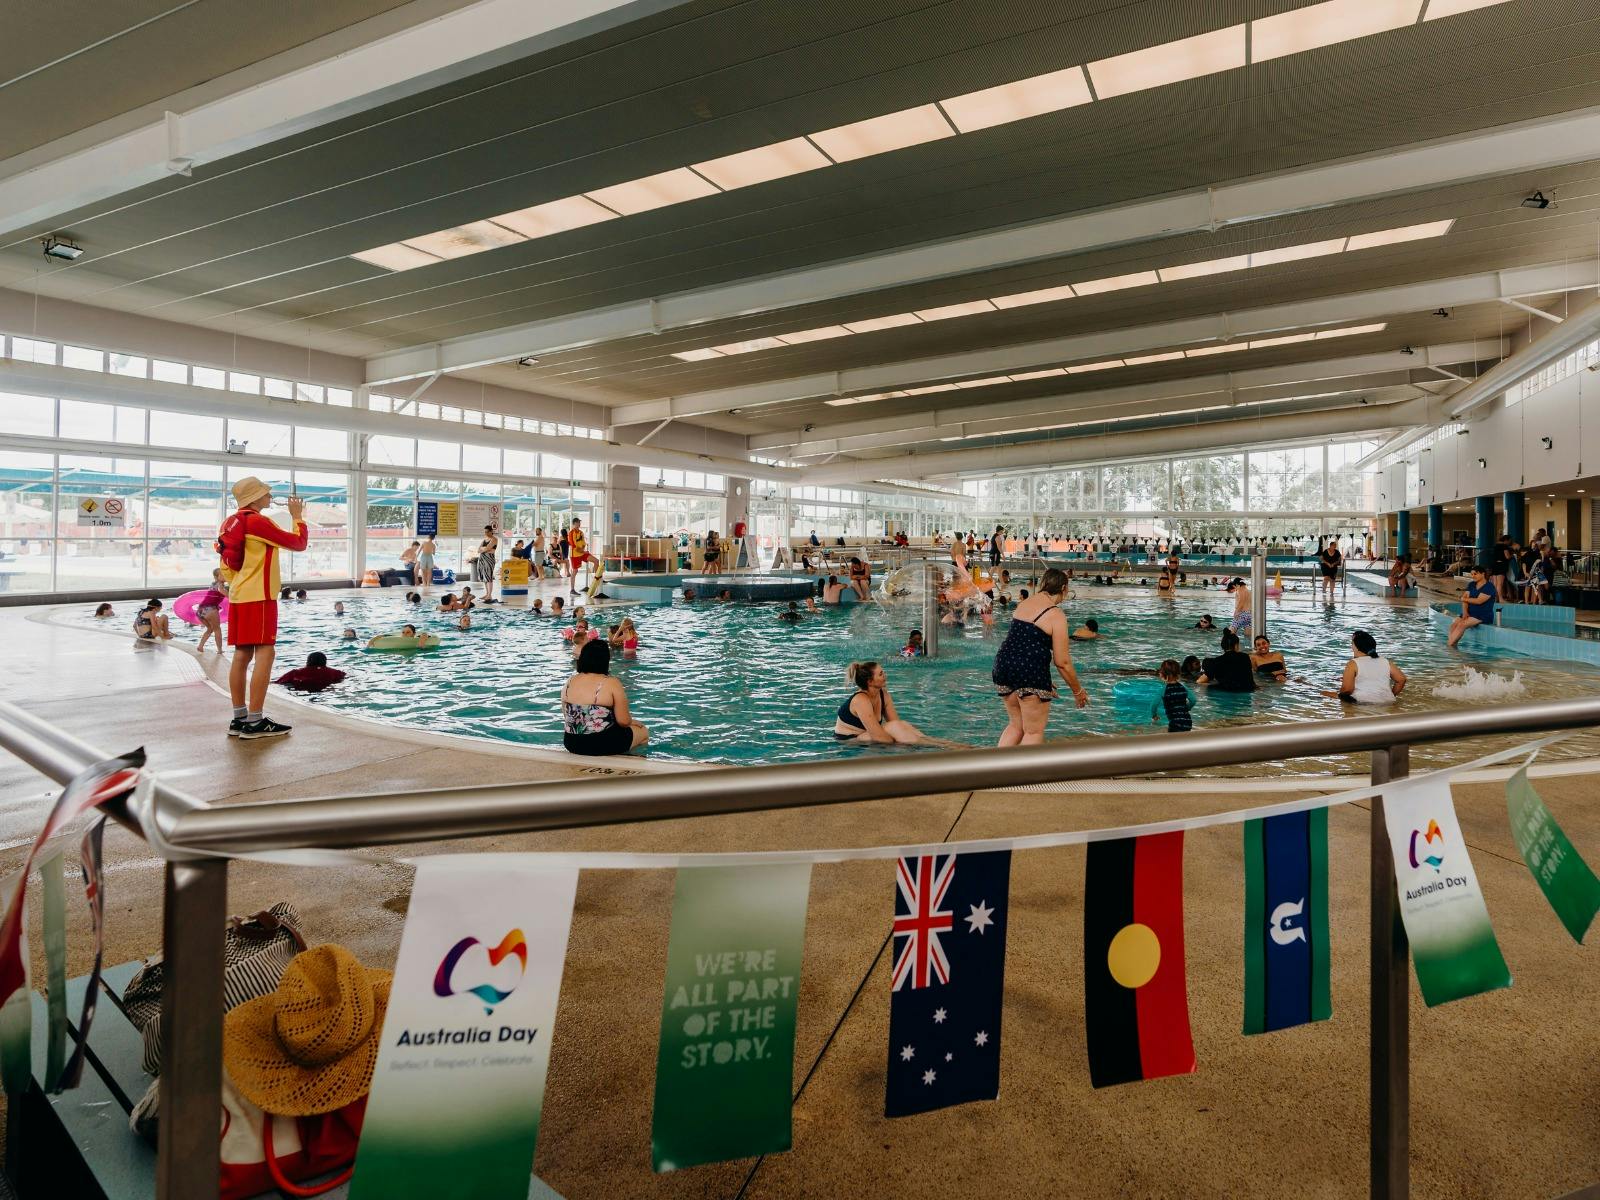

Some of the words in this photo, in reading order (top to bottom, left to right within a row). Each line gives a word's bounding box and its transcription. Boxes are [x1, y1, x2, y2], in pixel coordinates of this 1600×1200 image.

[1406, 881, 1445, 901] Australia
[1445, 876, 1467, 887] Day
[695, 949, 776, 976] WE'RE
[669, 983, 718, 1010] ALL
[726, 976, 794, 1003] PART
[683, 1011, 721, 1037] OF
[729, 1005, 776, 1033] THE
[396, 1027, 492, 1047] Australia
[498, 1026, 538, 1045] Day
[681, 1036, 772, 1068] STORY.
